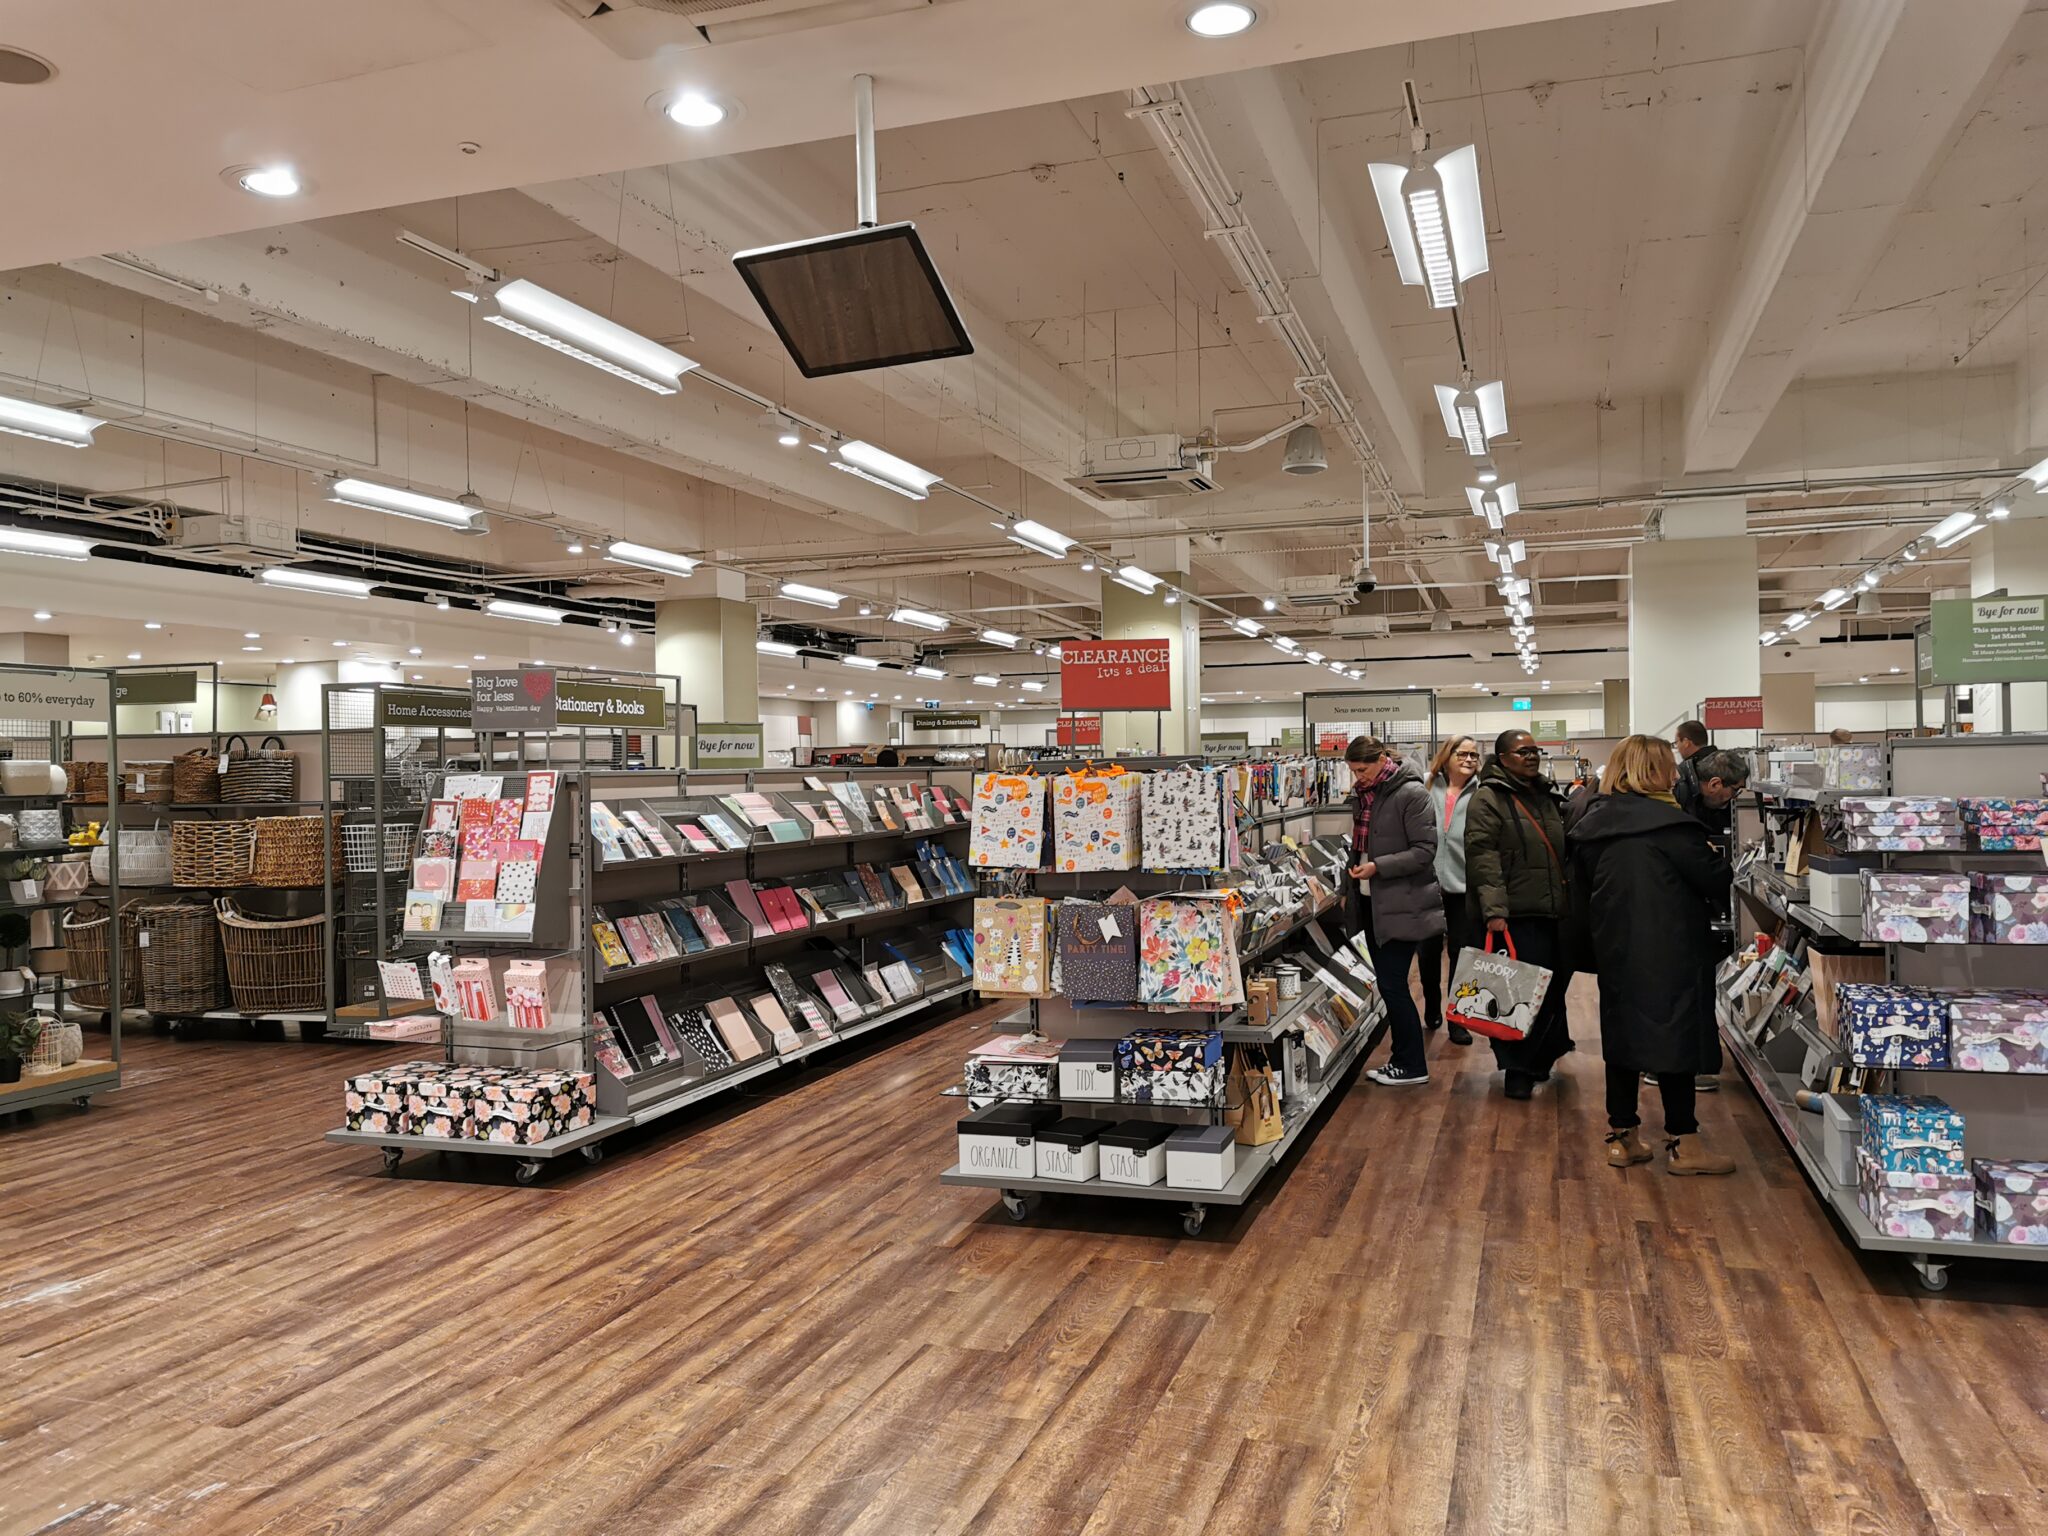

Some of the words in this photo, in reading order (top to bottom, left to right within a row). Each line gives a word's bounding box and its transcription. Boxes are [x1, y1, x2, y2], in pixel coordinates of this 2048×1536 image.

[1978, 607, 1997, 619] Bye
[1998, 606, 2014, 619] for
[2016, 607, 2039, 615] now
[1061, 648, 1170, 665] CLEARANCE
[1097, 667, 1120, 678] It's
[1138, 662, 1167, 674] deal
[476, 677, 493, 690] Big
[495, 677, 518, 688] love
[4, 692, 15, 703] to
[18, 691, 43, 704] 60%
[45, 695, 95, 709] everyday
[476, 691, 491, 702] for
[493, 692, 514, 702] less
[388, 703, 417, 716] Home
[419, 705, 472, 718] Accessories
[477, 705, 494, 713] Happy
[529, 705, 541, 713] day
[556, 695, 604, 717] Stationery
[606, 699, 615, 713] &
[616, 699, 645, 715] Books
[1704, 700, 1762, 709] CLEARANCE
[942, 718, 978, 727] Entertaining
[699, 739, 717, 752] Bye
[717, 739, 733, 752] for
[734, 740, 755, 750] now
[1204, 744, 1217, 753] Bye
[1216, 743, 1227, 753] for
[1067, 944, 1097, 954] PARTY
[1101, 944, 1126, 954] TIME!
[1473, 960, 1518, 979] SNOOPY
